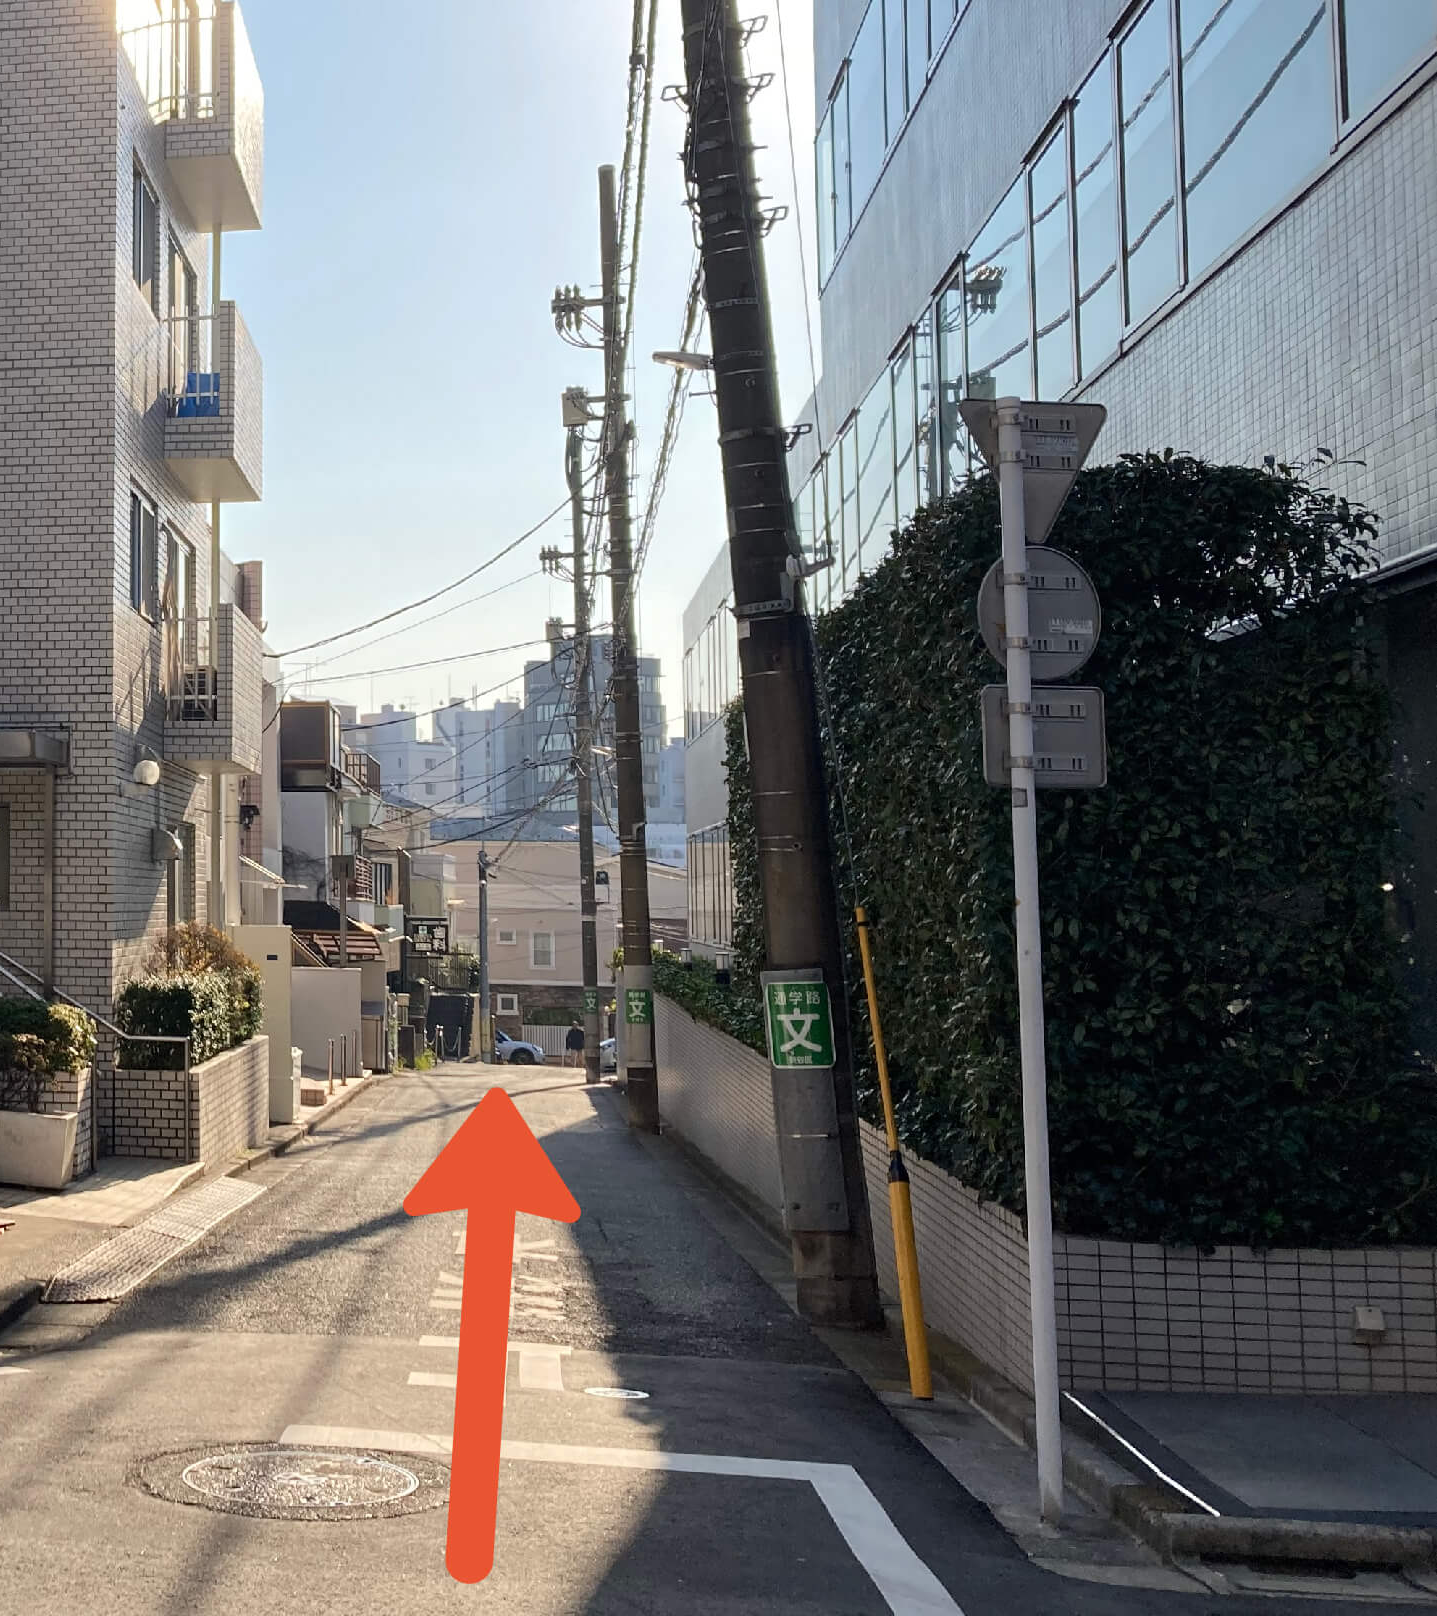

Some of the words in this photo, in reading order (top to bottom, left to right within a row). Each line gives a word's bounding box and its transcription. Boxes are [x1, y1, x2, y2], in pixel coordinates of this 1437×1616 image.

[773, 991, 821, 1005] 通学路
[776, 1007, 823, 1053] 文
